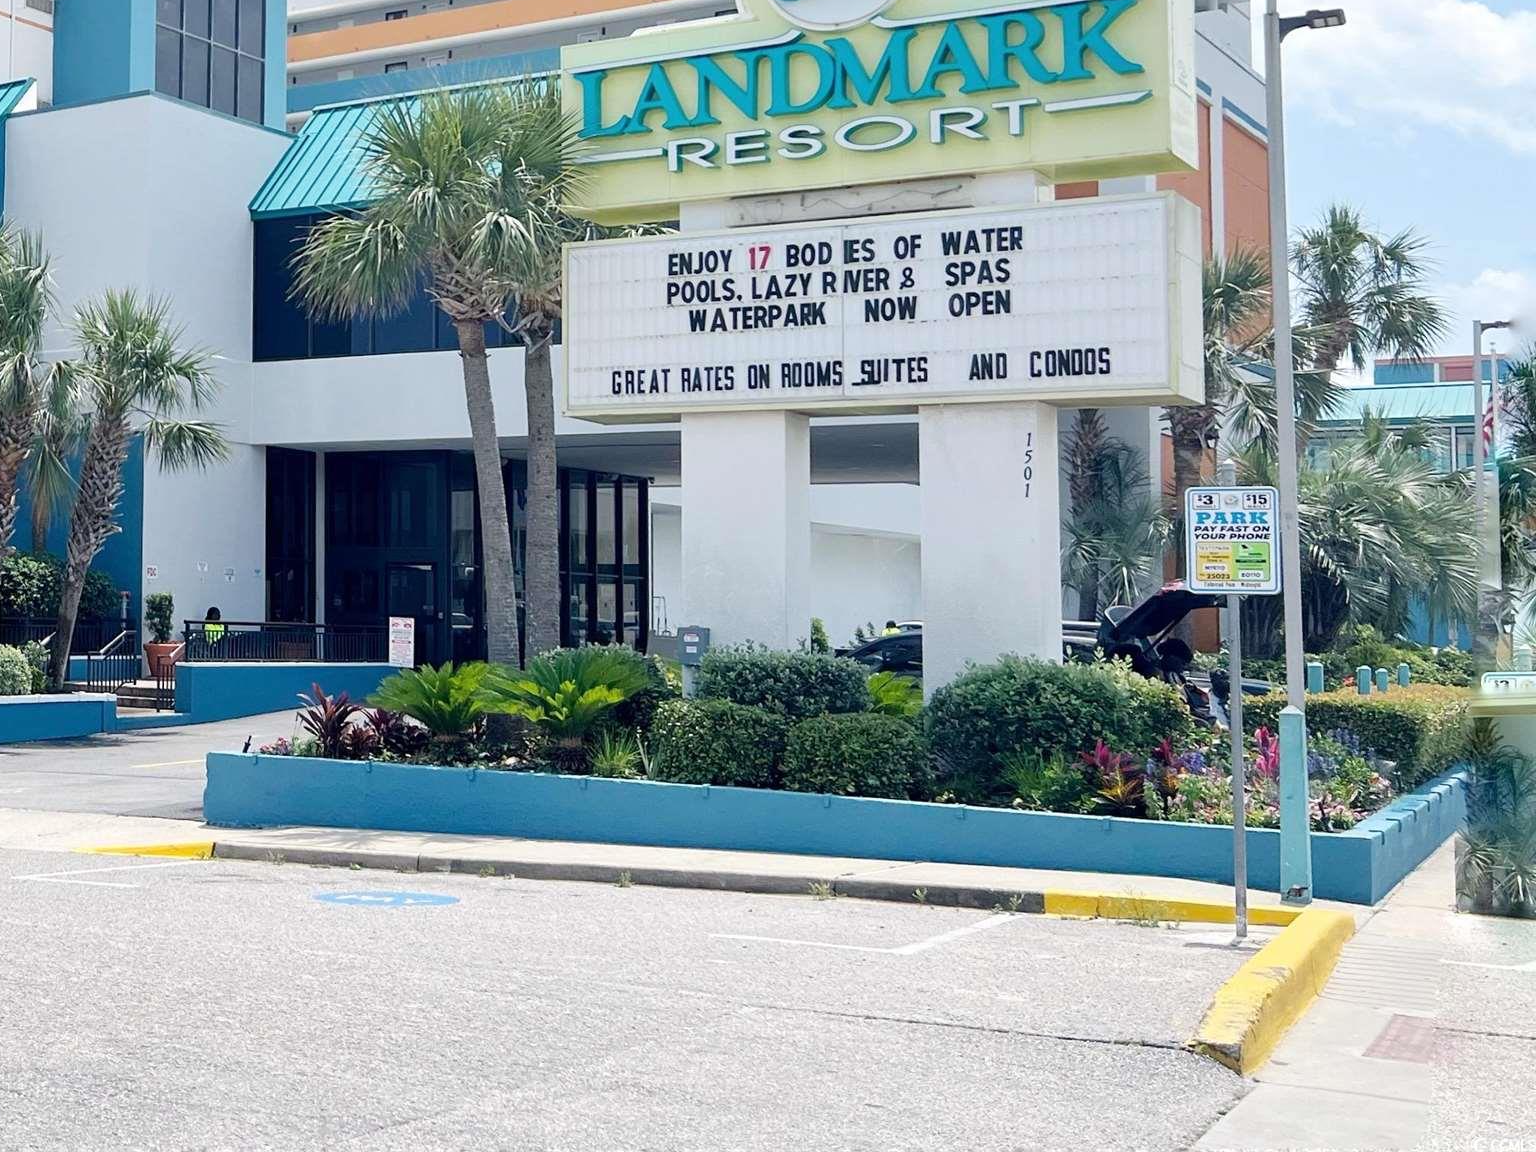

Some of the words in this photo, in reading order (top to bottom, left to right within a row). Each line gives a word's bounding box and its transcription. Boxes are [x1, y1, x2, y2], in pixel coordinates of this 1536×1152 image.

[667, 97, 1041, 173] RESORT
[668, 249, 732, 276] ENJOY
[749, 246, 771, 270] 17
[894, 234, 921, 260] OF
[941, 226, 1023, 256] WATER
[751, 272, 812, 300] LAZY
[899, 267, 915, 290] &
[945, 258, 1010, 287] SPAS
[689, 302, 826, 333] WATERPARK
[865, 296, 917, 322] NOW
[949, 289, 1011, 317] OPEN
[612, 368, 670, 395] GREAT
[681, 365, 734, 393] RATES
[748, 363, 770, 390] ON
[781, 360, 843, 388] ROOMS
[969, 352, 1007, 380] AND
[1029, 347, 1110, 378] CONDOS
[1024, 432, 1033, 498] 1501
[1195, 511, 1269, 525] PARK
[1197, 495, 1213, 505] $3
[1246, 495, 1267, 504] $15
